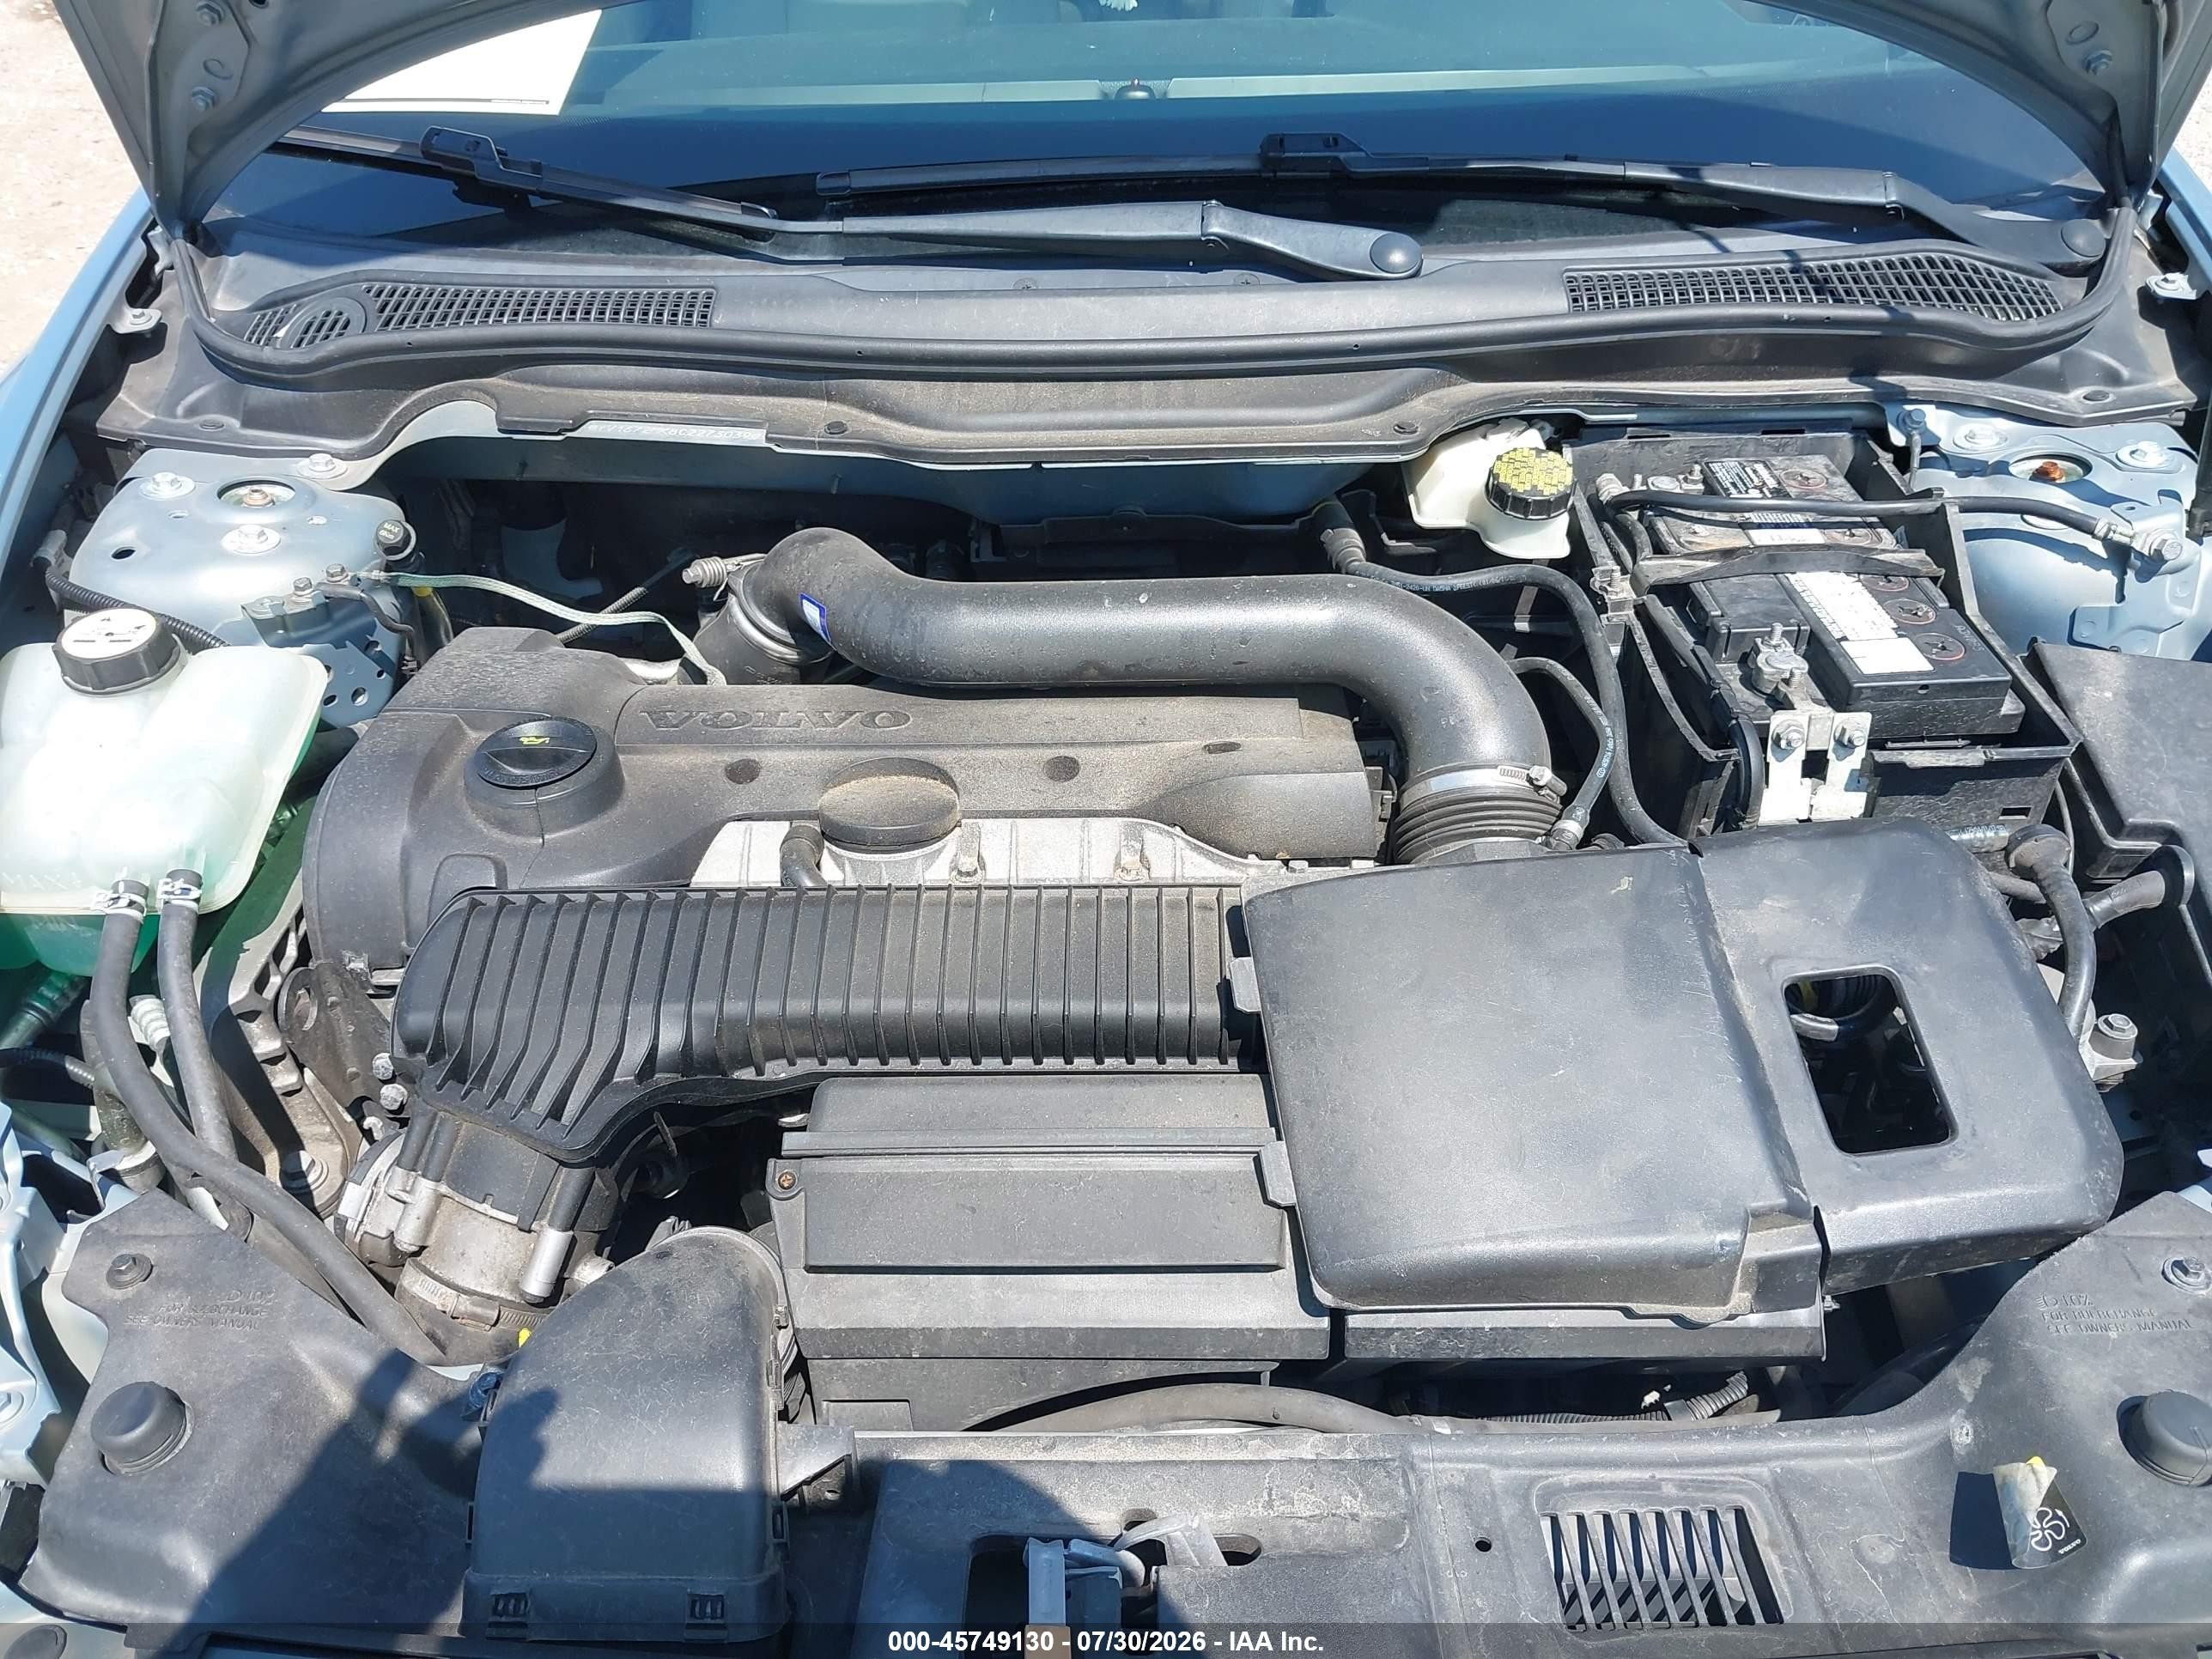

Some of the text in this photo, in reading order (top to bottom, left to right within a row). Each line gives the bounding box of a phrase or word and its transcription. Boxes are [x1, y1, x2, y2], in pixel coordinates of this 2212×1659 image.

[639, 710, 914, 730] VOLVO
[2041, 1310, 2069, 1322] FOR
[2047, 1323, 2073, 1334] SEE
[2137, 1318, 2194, 1332] MANUAL
[2058, 1539, 2081, 1554] VOLVO
